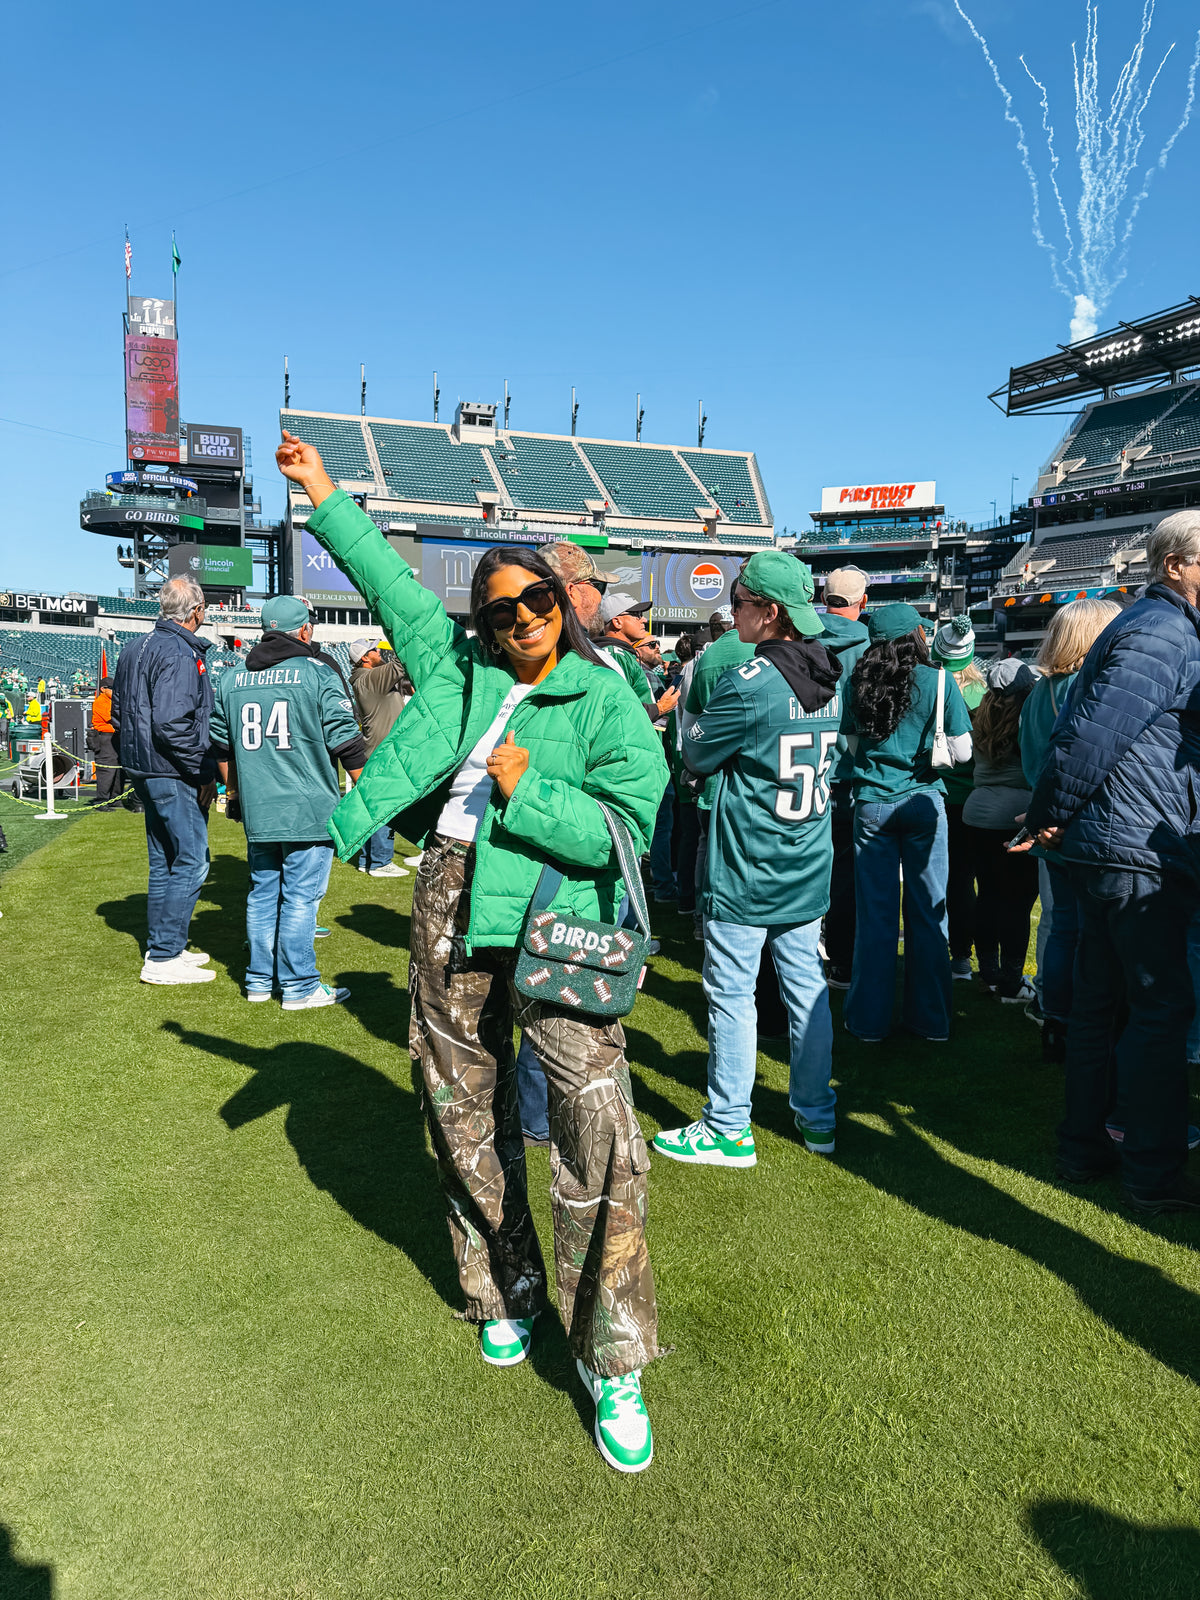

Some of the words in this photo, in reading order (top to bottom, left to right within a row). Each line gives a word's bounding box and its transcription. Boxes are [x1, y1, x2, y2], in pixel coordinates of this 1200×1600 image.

[199, 434, 230, 446] BUD
[194, 444, 236, 457] LIGHT
[142, 473, 169, 483] OFFICIAL
[169, 476, 183, 485] BEER
[1093, 486, 1121, 496] PREGAME
[870, 499, 906, 509] BANK
[125, 510, 142, 521] GO
[145, 511, 180, 524] BIRDS
[475, 528, 507, 540] Lincoln
[508, 532, 547, 542] Financial
[548, 534, 569, 543] Field
[204, 558, 234, 567] Lincoln
[692, 576, 722, 586] PEPSI
[322, 593, 347, 601] EAGLES
[16, 594, 87, 613] BETMGM
[651, 606, 666, 617] GO
[668, 607, 698, 618] BIRDS
[234, 668, 301, 688] MITCHELL
[241, 700, 292, 751] 84
[775, 730, 839, 822] 55
[550, 922, 613, 955] BIRDS
